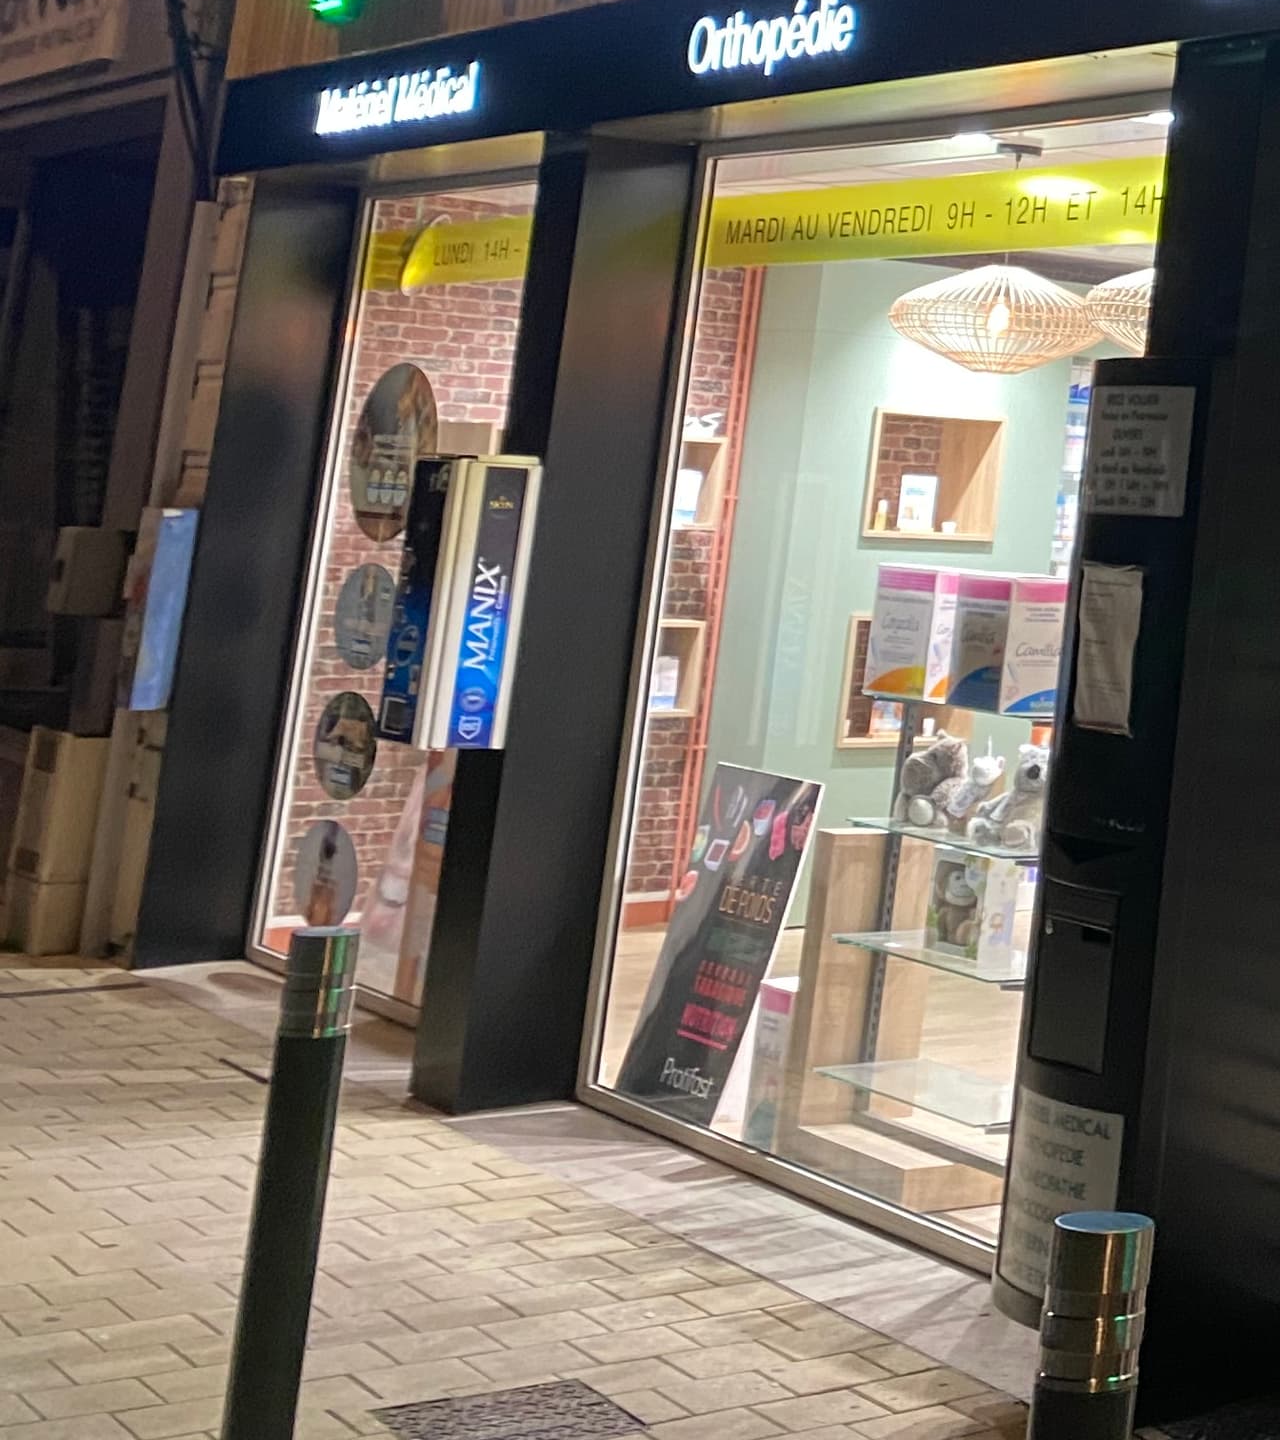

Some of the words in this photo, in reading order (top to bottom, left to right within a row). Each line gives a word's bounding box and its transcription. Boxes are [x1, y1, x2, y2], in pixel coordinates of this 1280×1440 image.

[394, 60, 481, 122] Médical
[725, 216, 784, 245] MARDI
[791, 214, 819, 242] AU
[828, 203, 933, 239] VENDREDI
[947, 201, 976, 230] 9H
[1004, 194, 1047, 227] 12H
[1066, 189, 1098, 222] ET
[1121, 184, 1166, 217] 14H
[433, 241, 474, 267] LUNDI
[485, 238, 510, 261] 14H
[462, 560, 501, 671] MANIX
